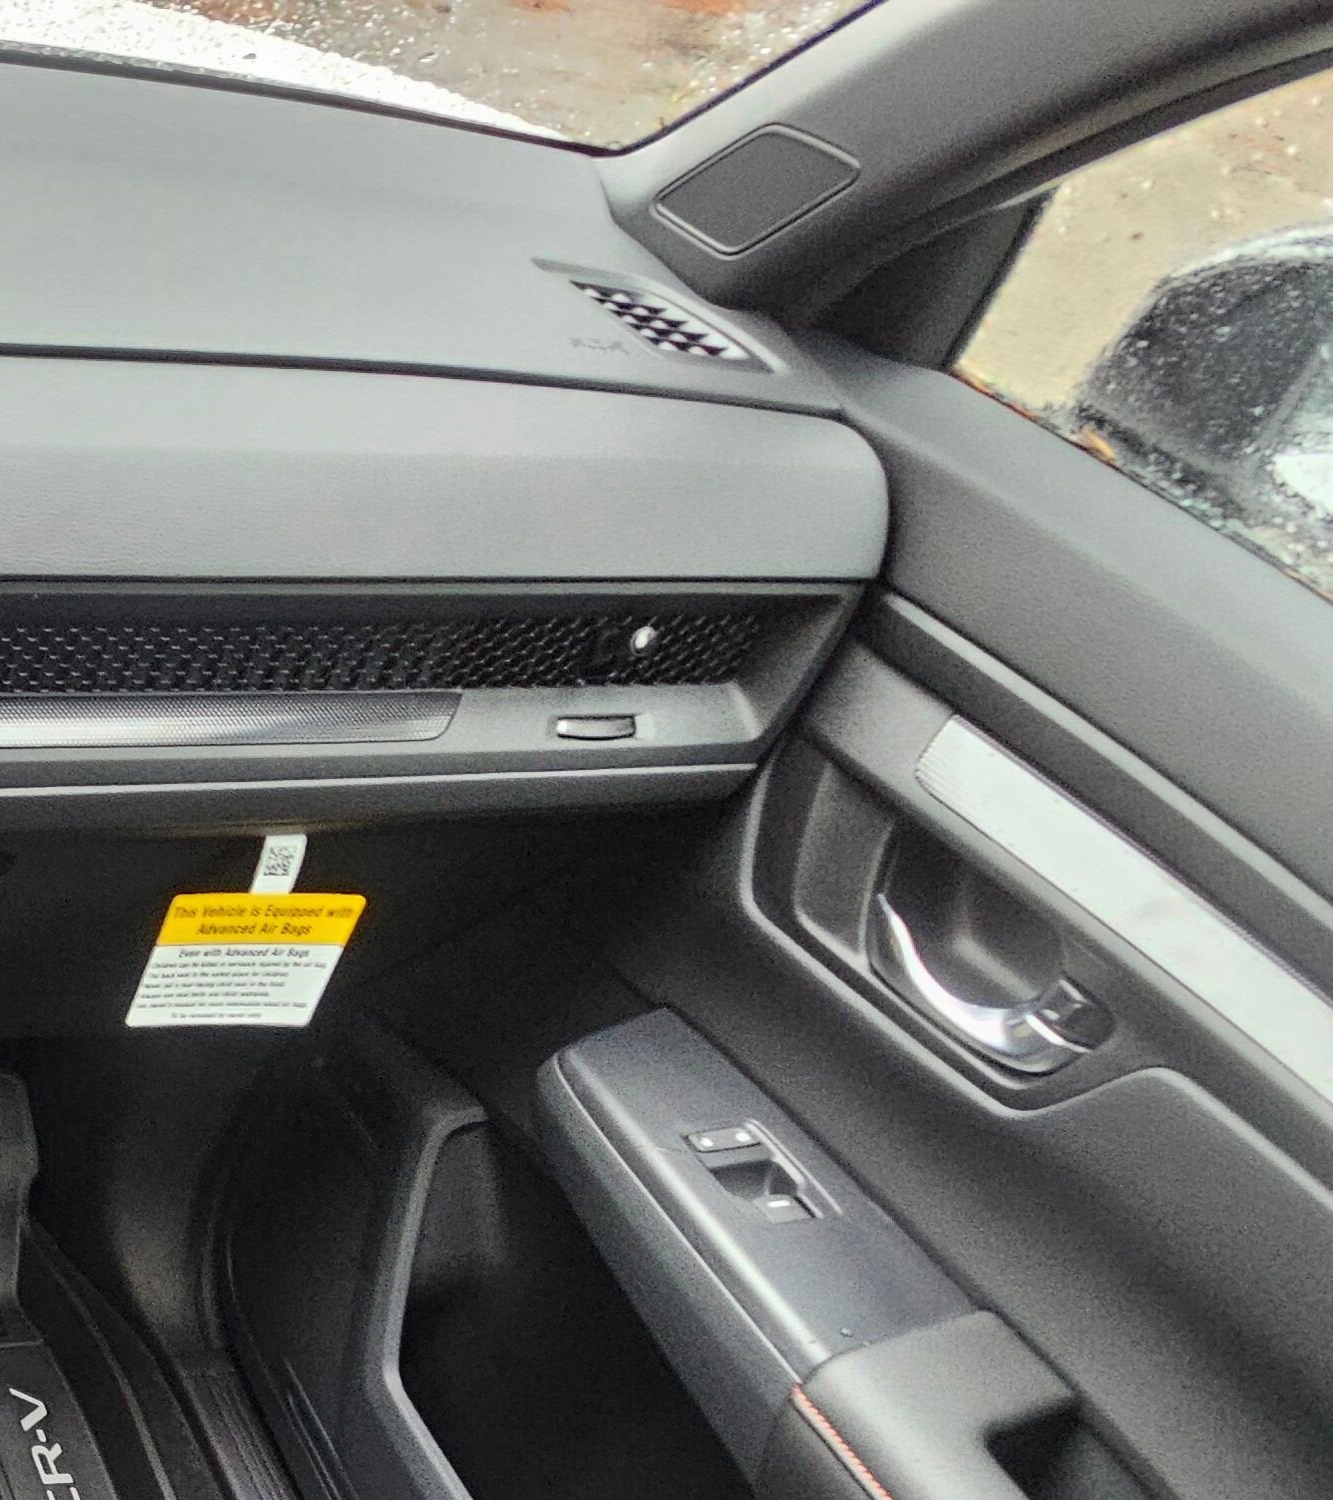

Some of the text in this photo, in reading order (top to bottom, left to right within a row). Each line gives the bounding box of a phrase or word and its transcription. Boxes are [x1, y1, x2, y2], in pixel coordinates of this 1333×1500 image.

[174, 906, 197, 918] This
[203, 905, 246, 917] Vehicle
[264, 904, 323, 918] Equipped
[327, 906, 354, 918] with
[196, 922, 312, 937] Advanced Air Bags
[226, 949, 269, 957] Advanced
